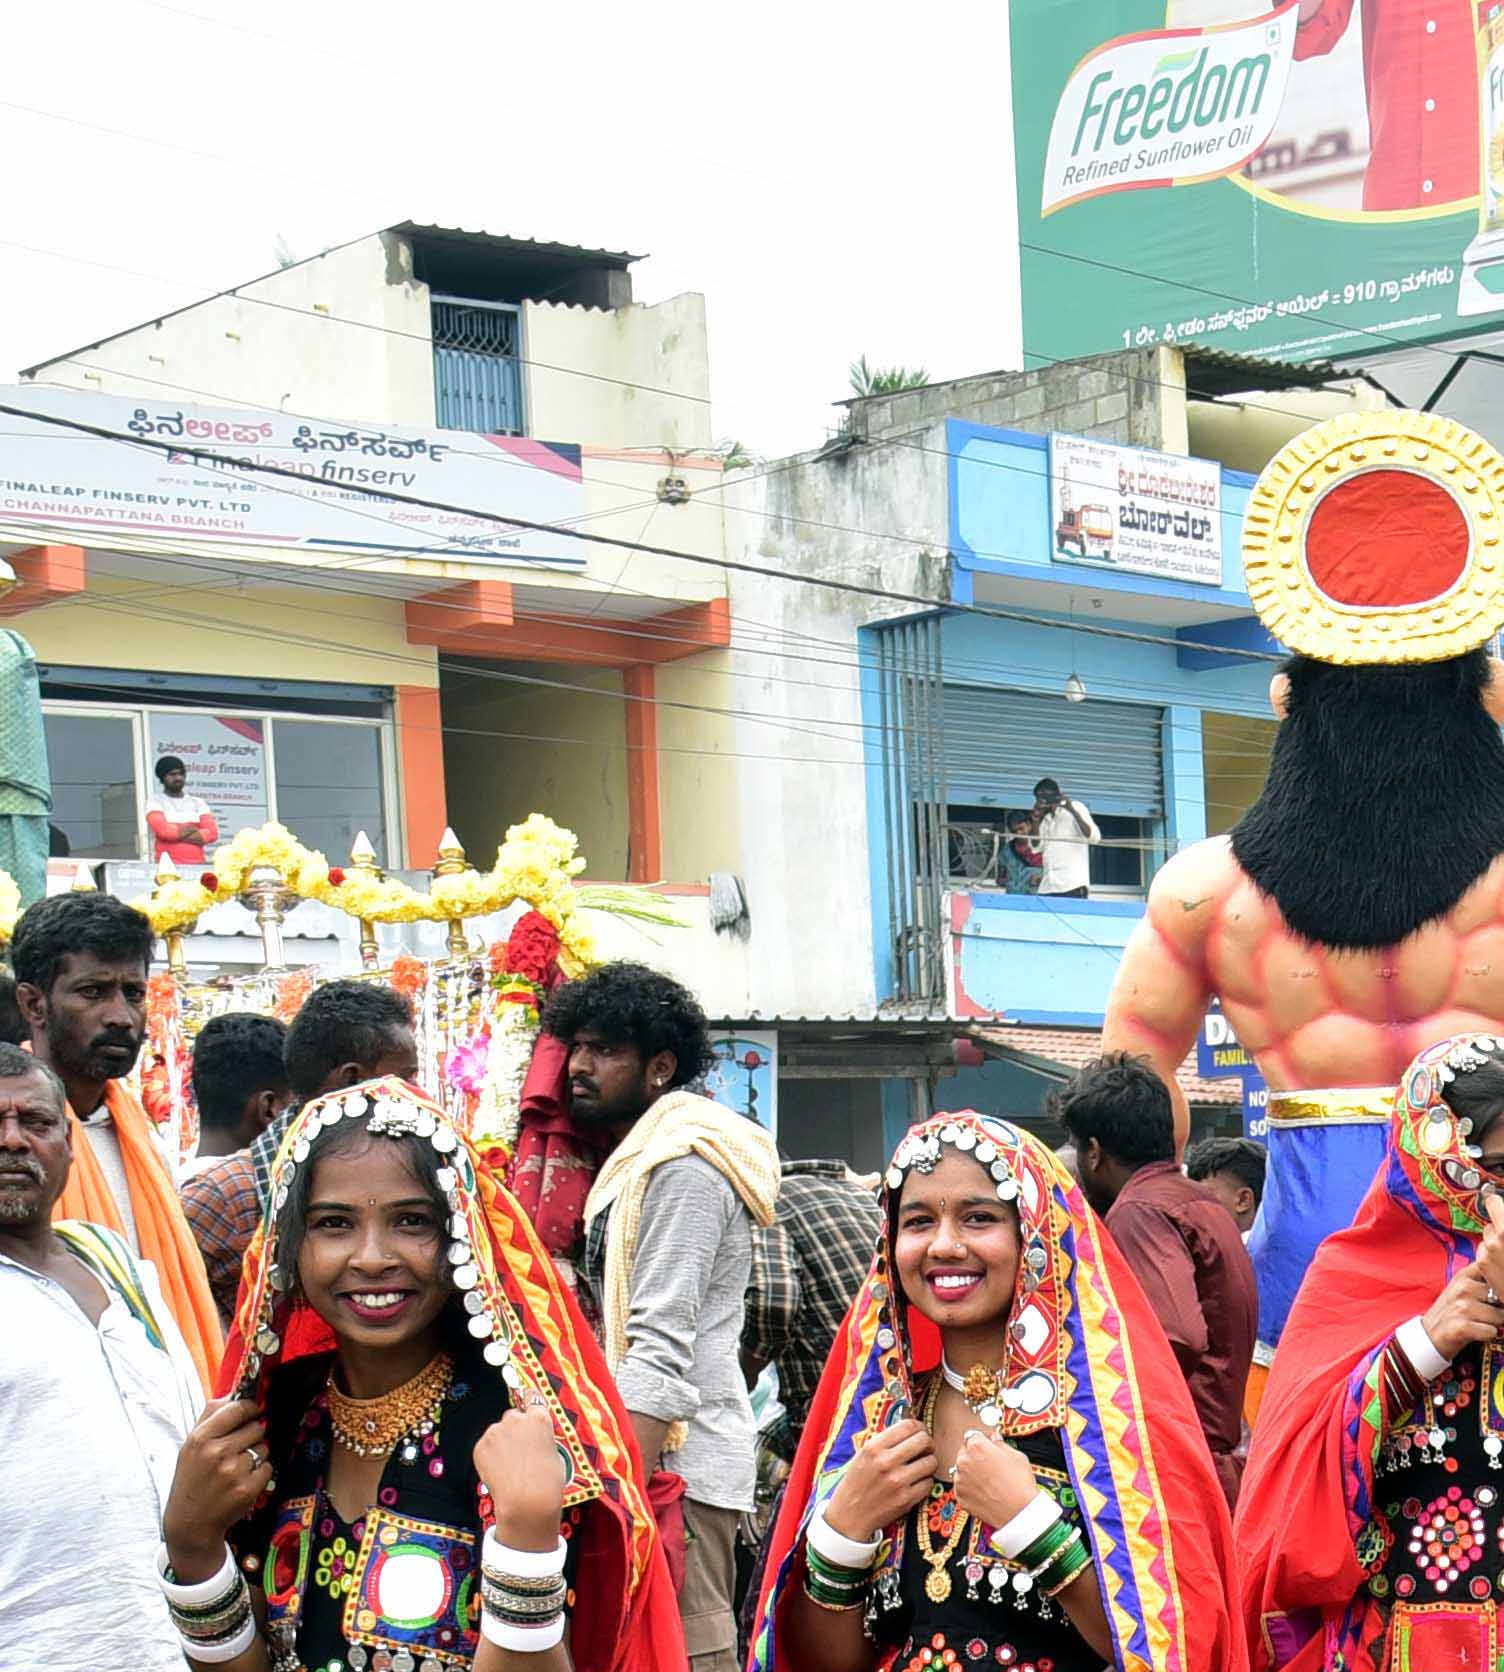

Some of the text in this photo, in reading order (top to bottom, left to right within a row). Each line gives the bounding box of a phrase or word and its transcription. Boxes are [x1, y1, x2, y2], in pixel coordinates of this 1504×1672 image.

[1070, 46, 1272, 157] Freedom
[1062, 125, 1253, 186] Refined Sunflower Oil
[1122, 329, 1132, 348] 1
[1344, 279, 1377, 305] 910
[320, 459, 417, 488] finserv
[3, 497, 246, 530] CHANNAPATTANA BRANCH
[92, 489, 170, 506] FINSERV
[176, 497, 214, 510] PVT.
[220, 501, 251, 513] LTD
